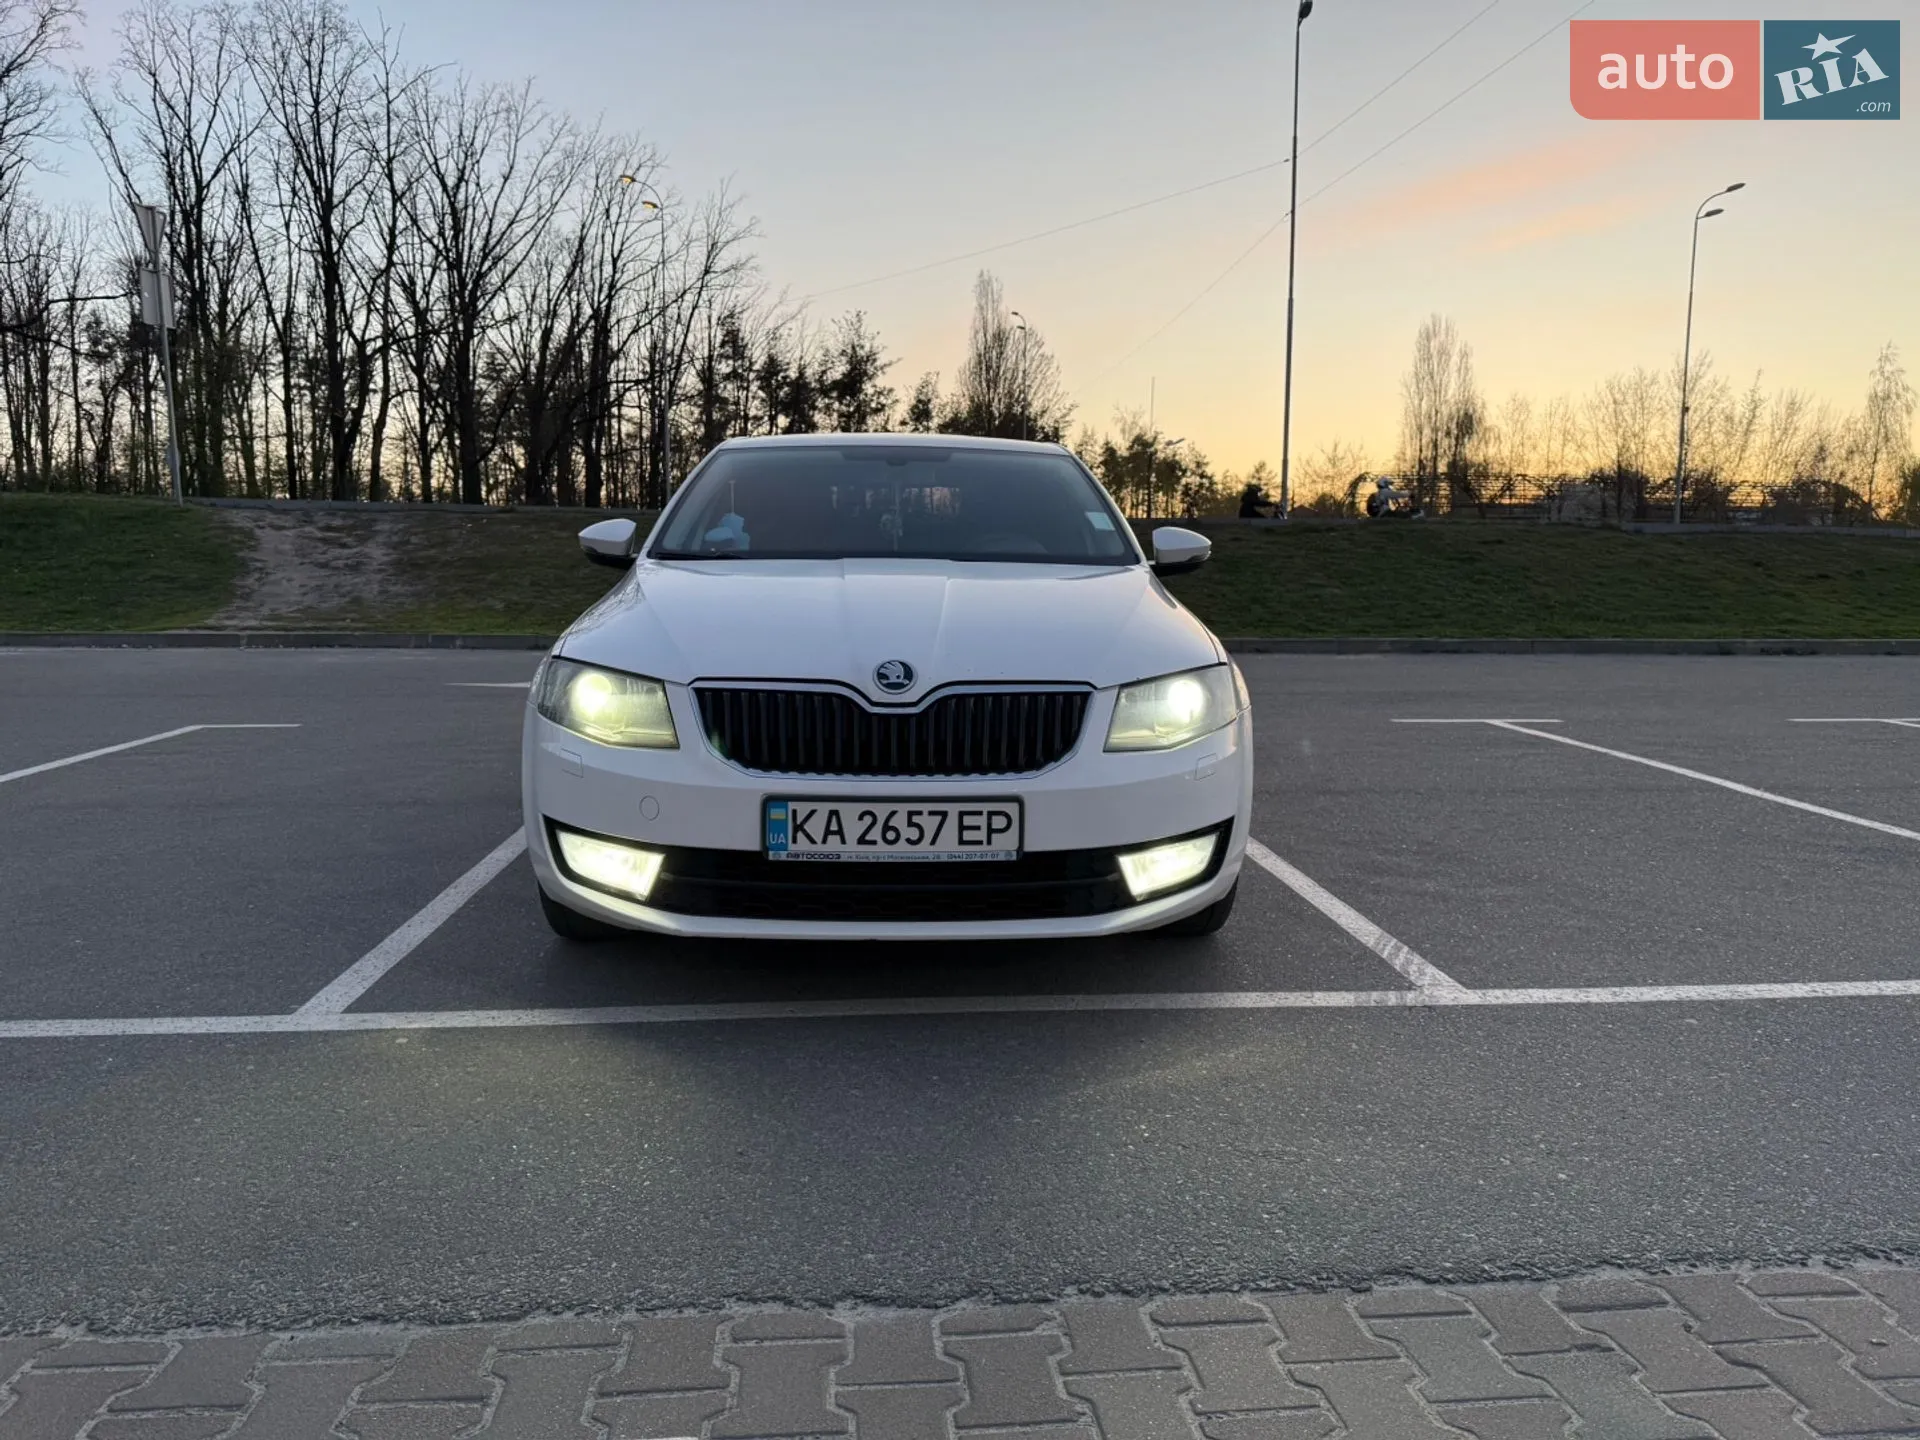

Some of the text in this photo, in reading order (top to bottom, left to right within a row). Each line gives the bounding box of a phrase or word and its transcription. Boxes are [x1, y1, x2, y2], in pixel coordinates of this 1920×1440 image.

[769, 833, 786, 845] UA
[791, 808, 1013, 846] KA 2657 EP
